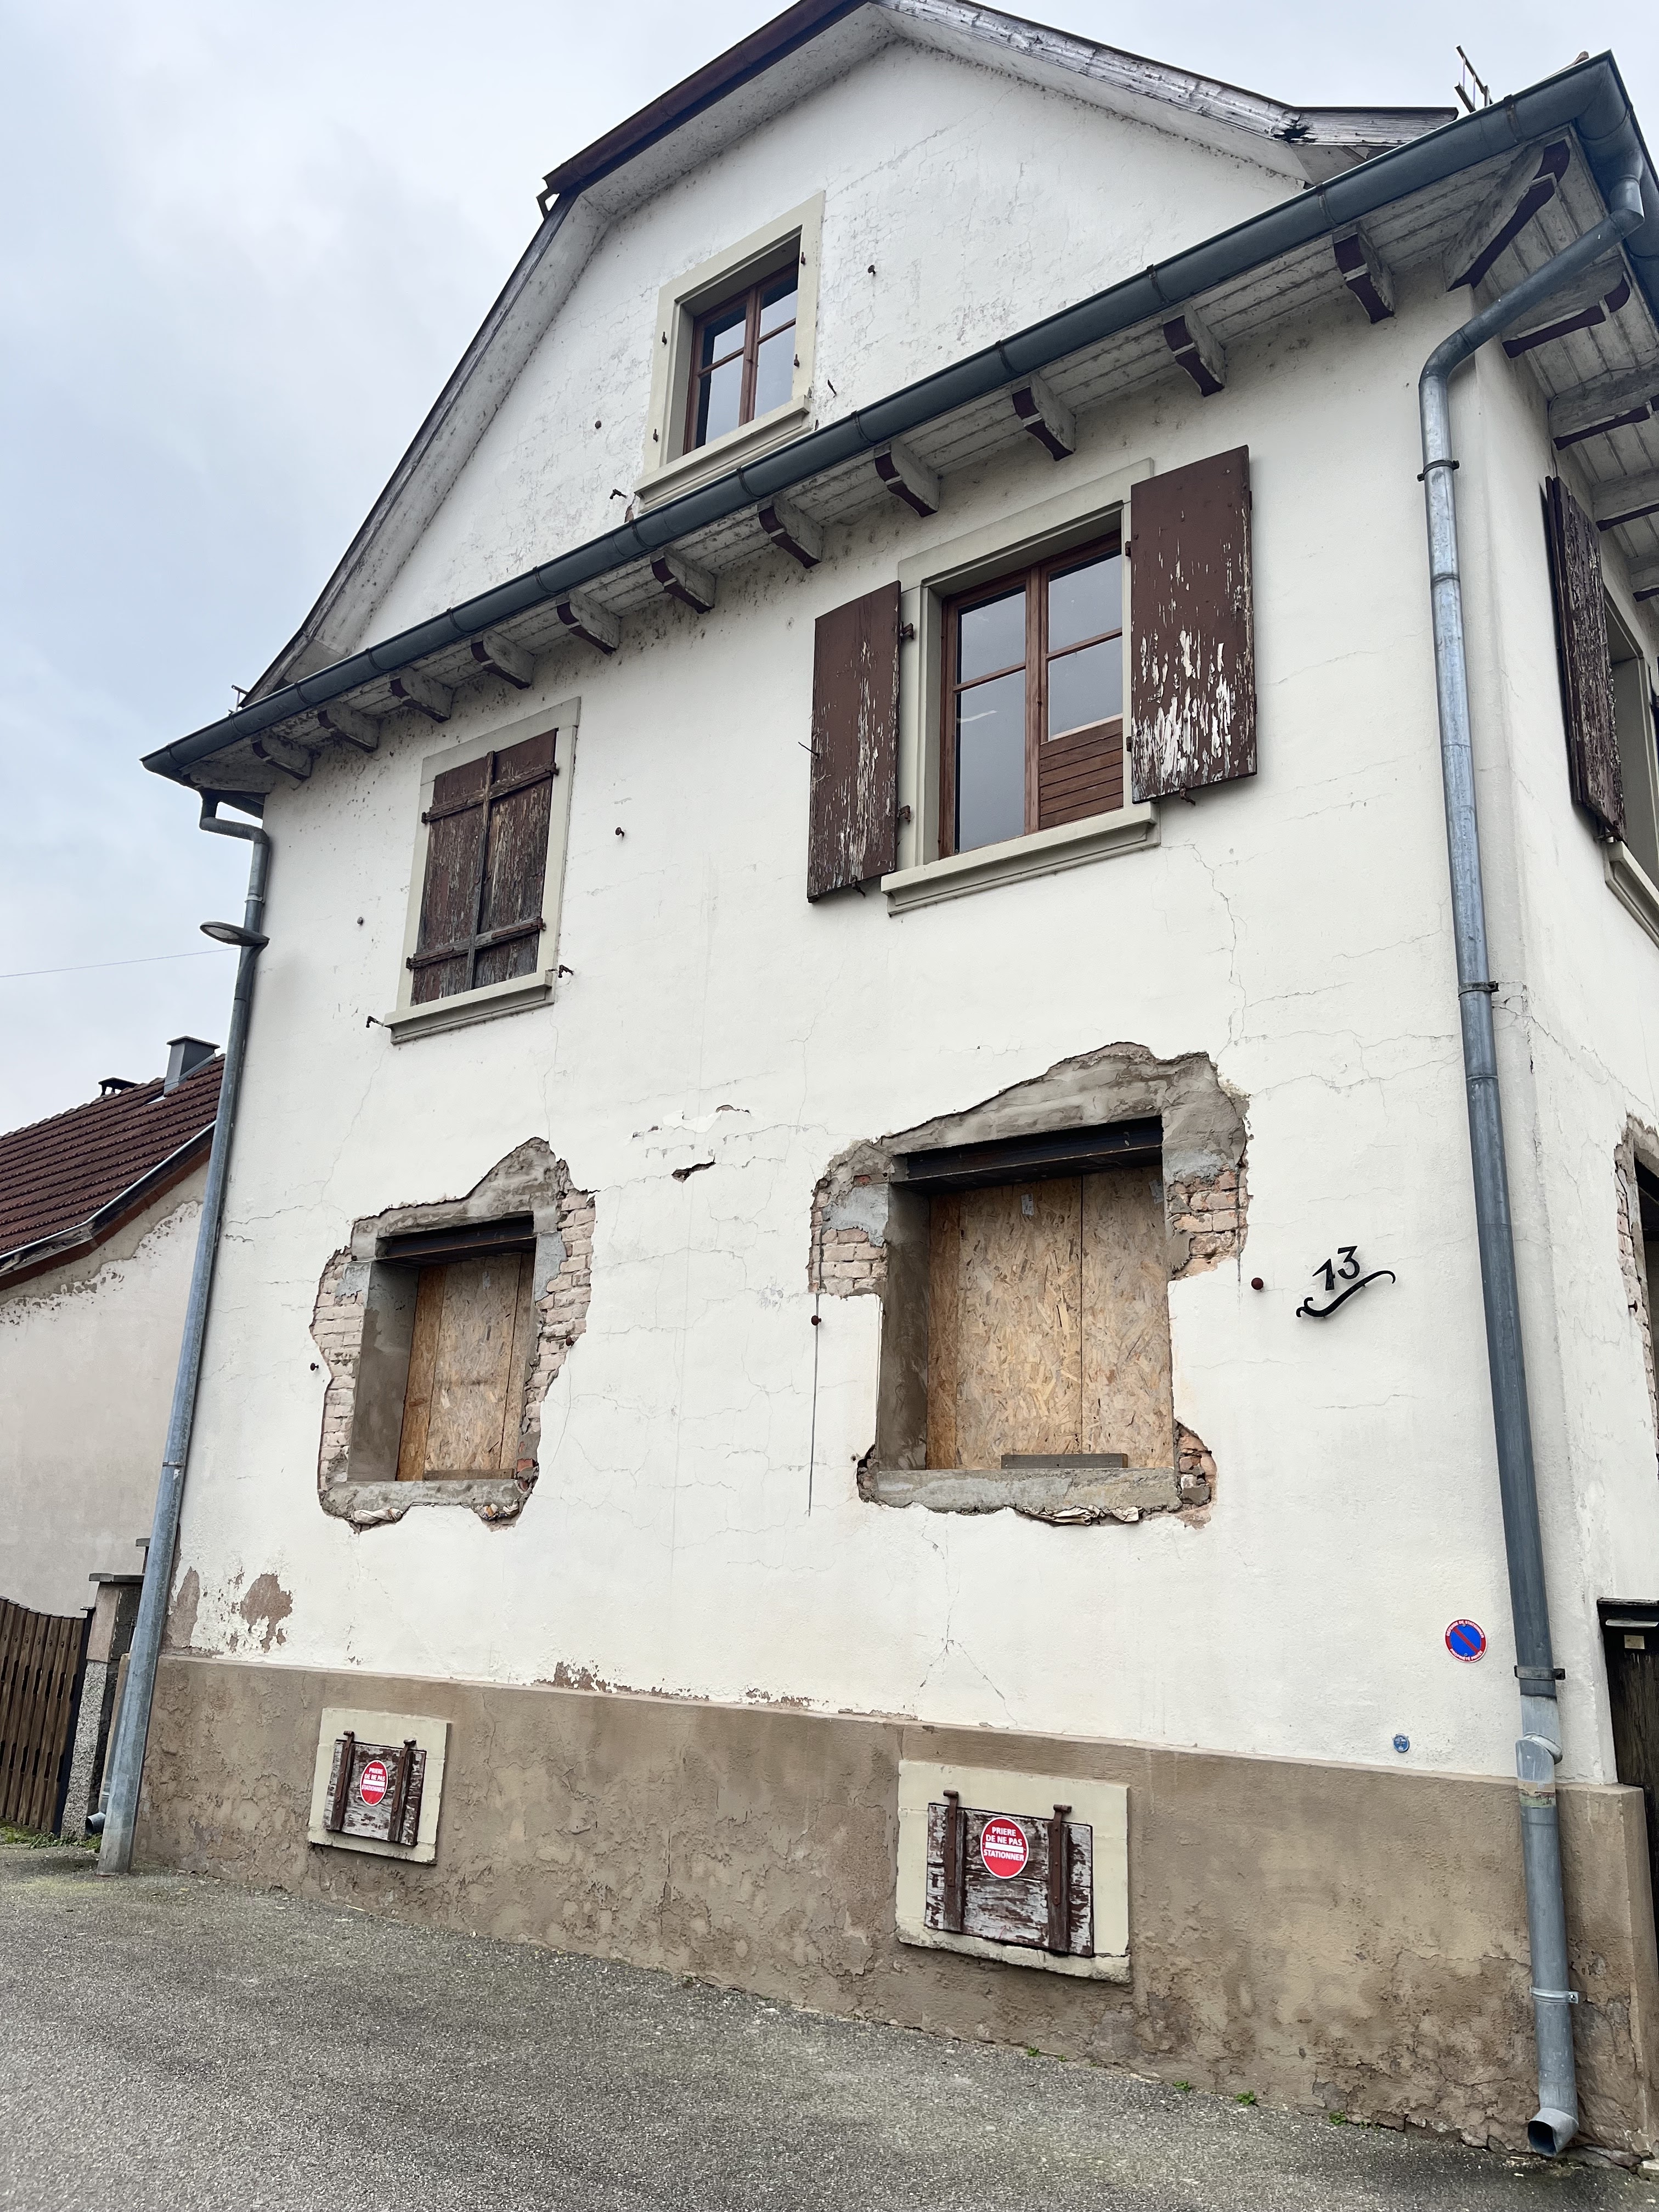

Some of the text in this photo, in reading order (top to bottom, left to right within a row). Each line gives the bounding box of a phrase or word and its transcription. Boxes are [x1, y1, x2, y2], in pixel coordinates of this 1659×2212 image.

[1312, 1245, 1360, 1291] 13
[1464, 1620, 1485, 1638] STATIONNER
[362, 1784, 385, 1793] STATIONNER
[991, 1826, 1017, 1837] PRIERE
[985, 1834, 1023, 1846] DE NE PAS
[983, 1849, 1025, 1862] STATIONNER
